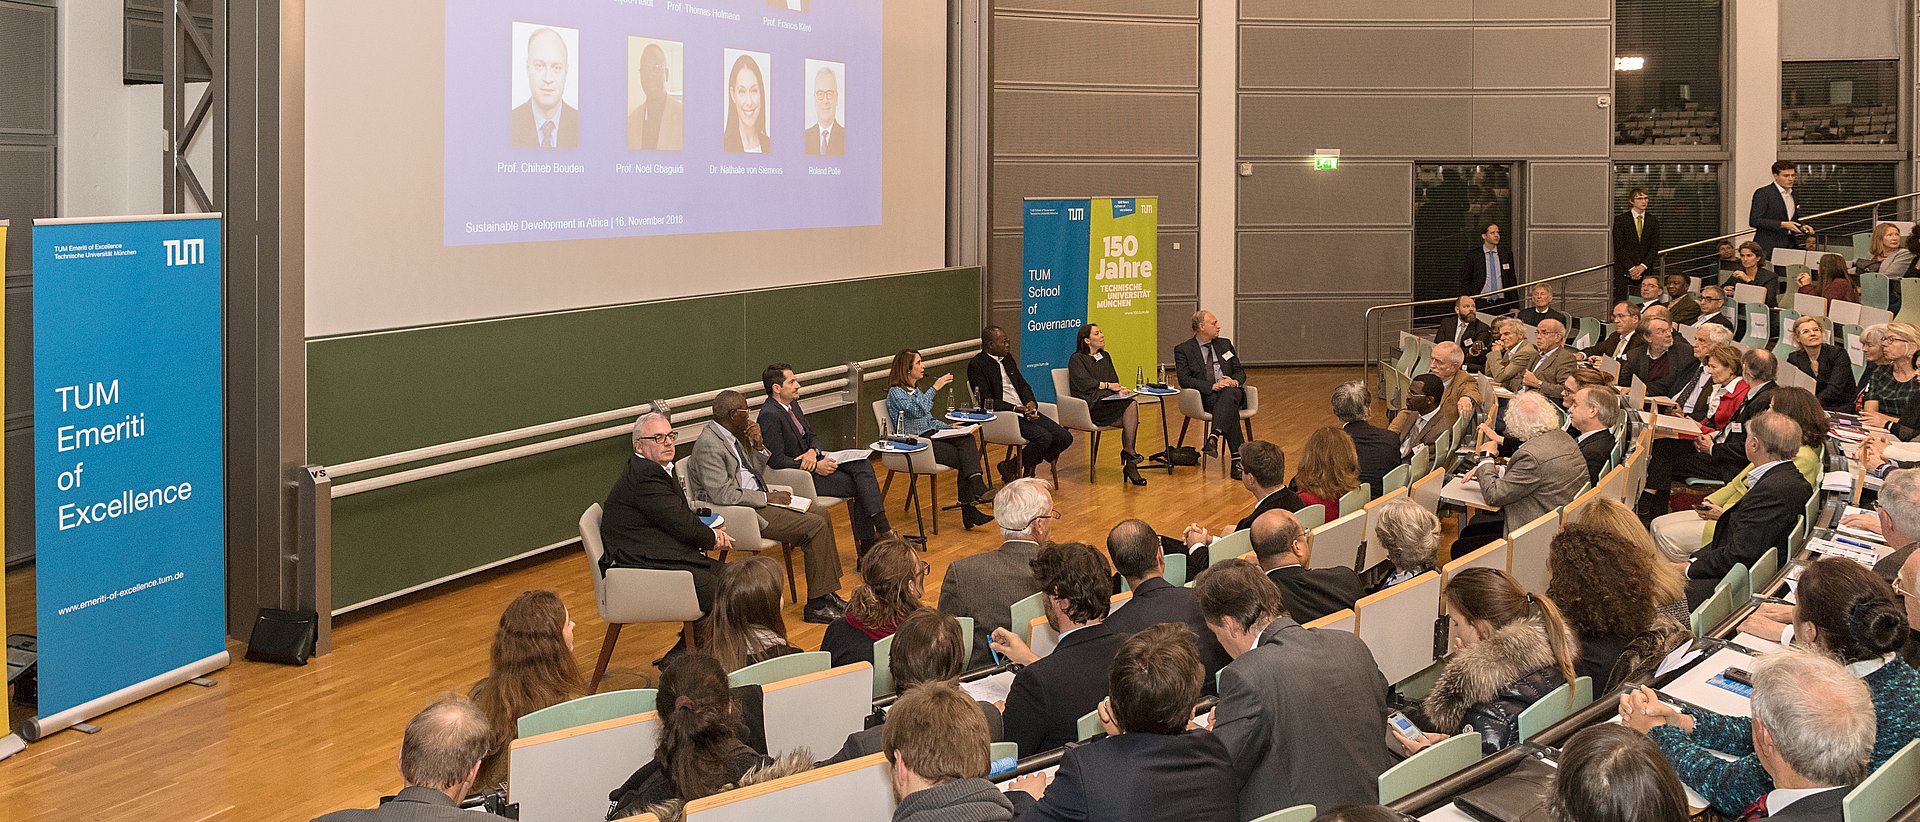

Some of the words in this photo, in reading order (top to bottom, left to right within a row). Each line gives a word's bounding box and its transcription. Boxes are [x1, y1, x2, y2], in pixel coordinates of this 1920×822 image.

[667, 0, 682, 13] Prof.
[685, 3, 711, 17] Thomas
[712, 8, 740, 21] Hofmann
[763, 16, 777, 27] Prof.
[778, 19, 799, 31] Francis
[497, 162, 518, 173] Prof.
[521, 162, 551, 173] Chiheb
[553, 162, 585, 174] Bouden
[616, 163, 634, 174] Prof.
[709, 164, 719, 175] Dr.
[720, 164, 745, 175] Nathalie
[746, 166, 757, 175] von
[758, 165, 783, 175] Siemens
[808, 166, 827, 175] Roland
[1068, 207, 1084, 221] TUM
[1140, 204, 1153, 214] TUM
[465, 220, 519, 233] Sustainable
[521, 218, 576, 232] Development
[577, 218, 585, 229] in
[586, 216, 609, 229] Africa
[615, 215, 627, 227] 16.
[628, 214, 664, 227] November
[666, 213, 684, 225] 2018
[68, 244, 87, 252] Emeriti
[88, 243, 94, 251] of
[94, 242, 122, 251] Excellence
[163, 238, 204, 266] TUM
[1103, 235, 1138, 257] 150
[54, 252, 85, 260] Technische
[85, 250, 113, 259] Universität
[113, 249, 137, 257] München
[1028, 268, 1051, 281] TUM
[1094, 256, 1153, 280] Jahre
[1028, 284, 1060, 298] School
[1100, 283, 1143, 293] TECHNISCHE
[1107, 288, 1151, 300] UNIVERSITÄT
[1027, 303, 1038, 315] of
[1096, 298, 1132, 309] MÜNCHEN
[1027, 318, 1082, 332] Governance
[55, 378, 119, 413] TUM
[57, 411, 145, 453] Emeriti
[57, 462, 84, 491] of
[58, 482, 192, 531] Excellence
[57, 570, 185, 616] www.emeriti-of-excellence.tum.de
